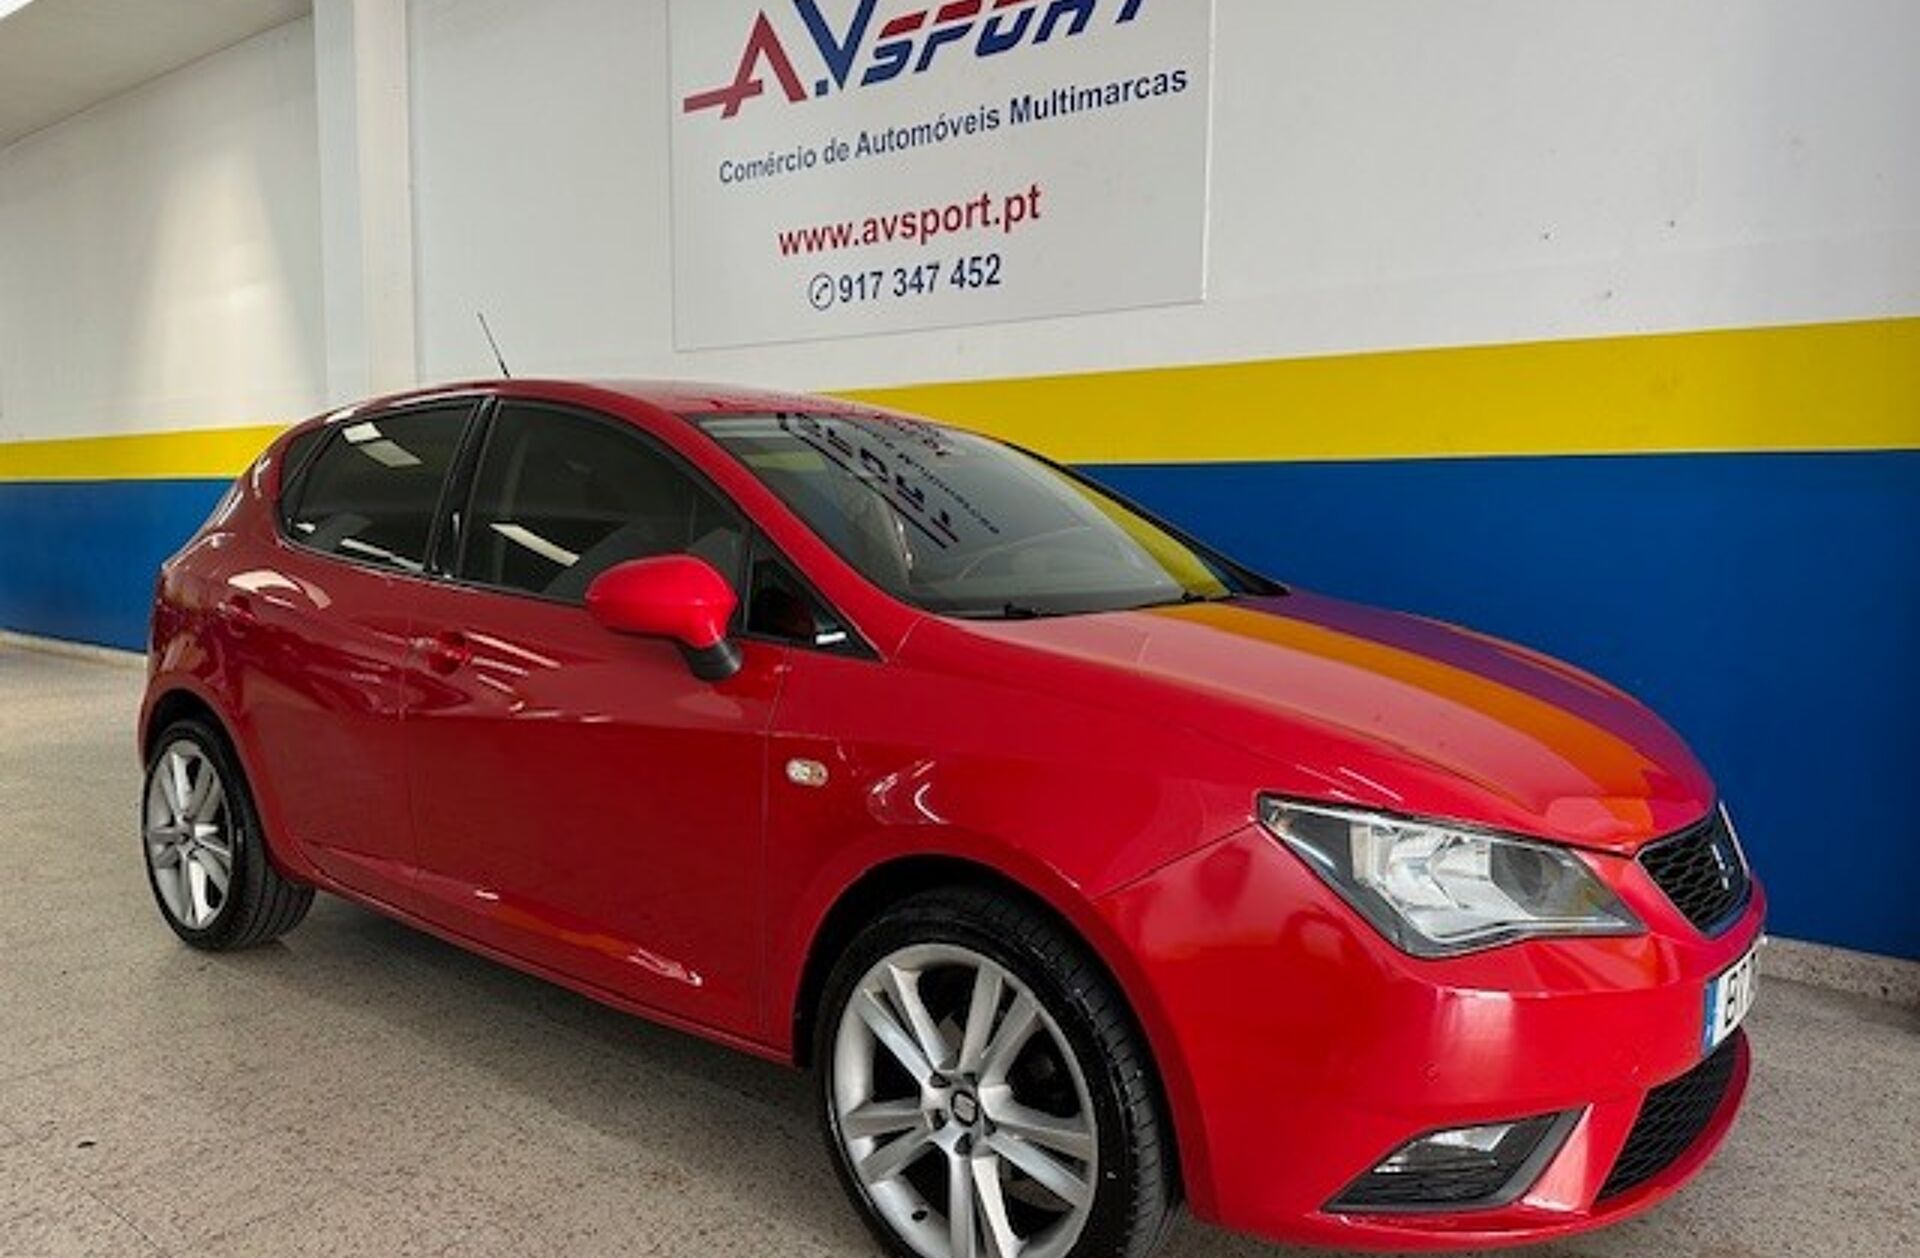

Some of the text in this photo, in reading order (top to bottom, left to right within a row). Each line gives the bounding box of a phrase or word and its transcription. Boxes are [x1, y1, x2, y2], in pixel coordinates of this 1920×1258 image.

[719, 70, 1188, 184] Comércio de Automóveis Multimarcas
[778, 184, 1042, 256] www.avsport.pt
[839, 255, 1001, 302] 917 347 452
